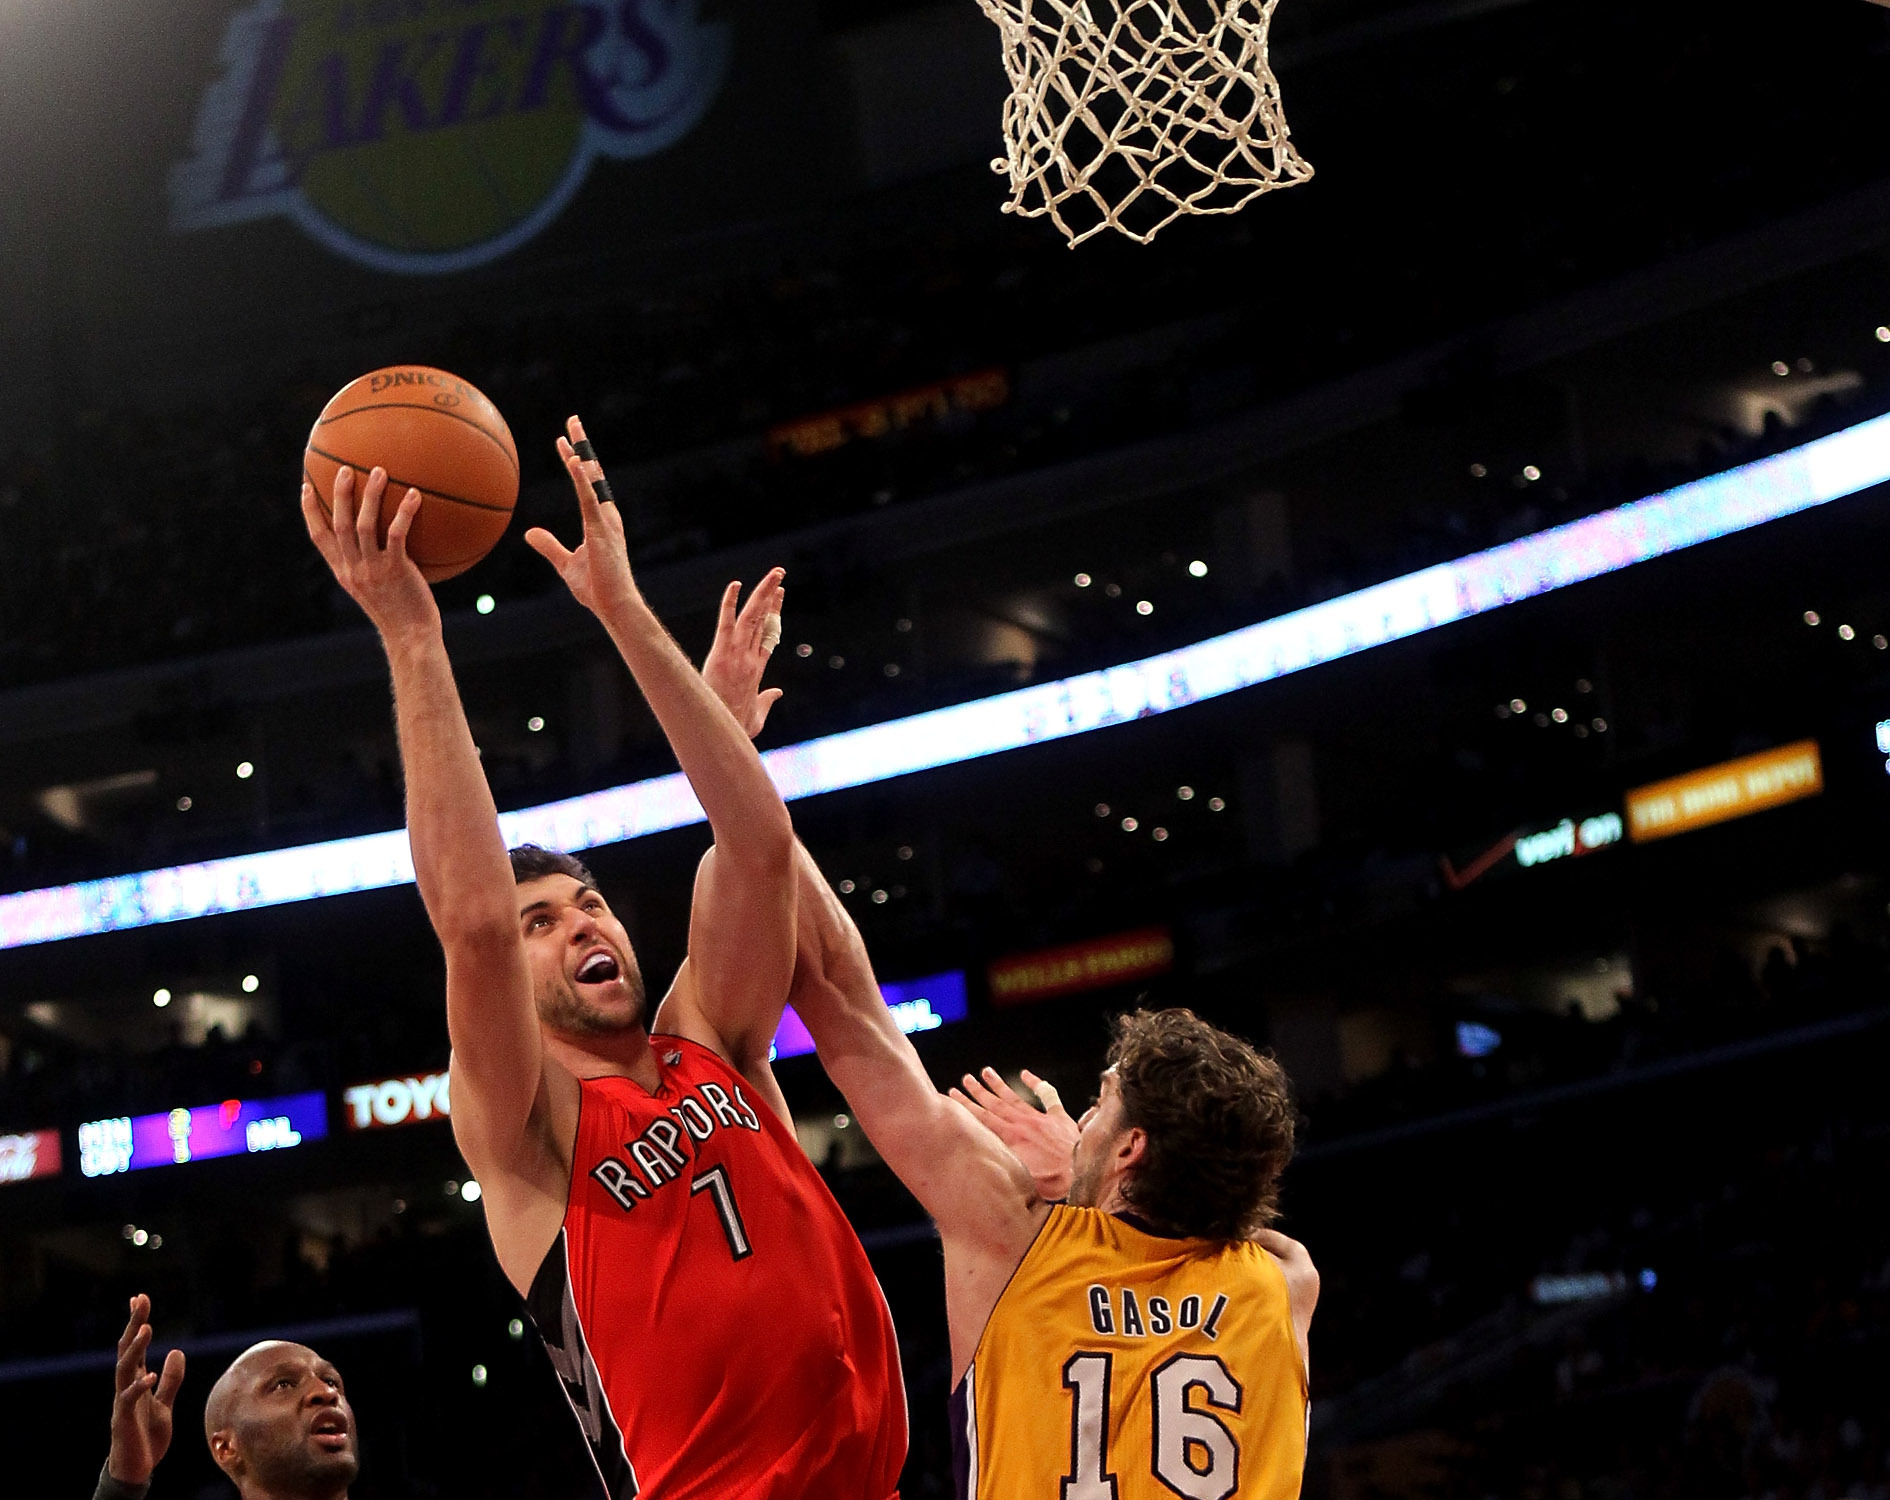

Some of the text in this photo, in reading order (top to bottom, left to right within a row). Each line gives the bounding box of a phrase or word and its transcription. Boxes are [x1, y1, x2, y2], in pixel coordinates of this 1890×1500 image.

[205, 0, 698, 203] LAKERS
[690, 1162, 753, 1262] 7
[1088, 1284, 1230, 1341] GASOL
